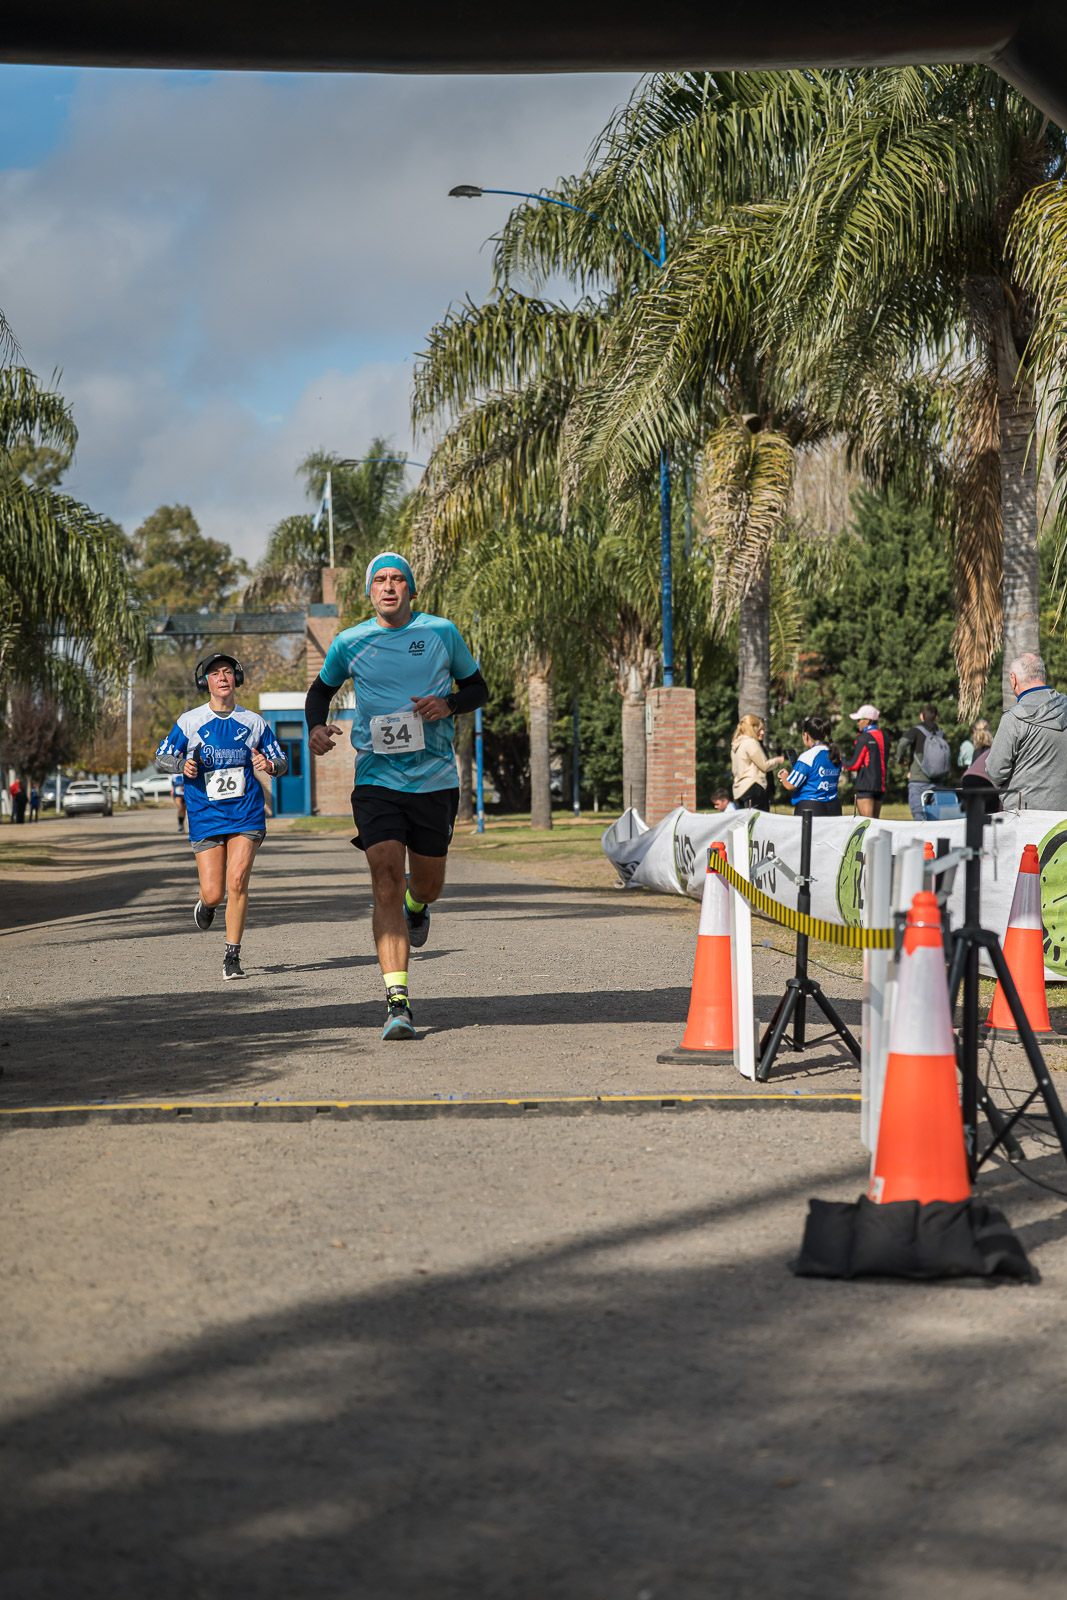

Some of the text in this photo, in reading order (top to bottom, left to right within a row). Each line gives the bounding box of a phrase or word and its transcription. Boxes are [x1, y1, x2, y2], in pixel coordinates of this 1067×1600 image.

[409, 640, 425, 649] AG
[380, 723, 412, 745] 34
[203, 744, 215, 768] 3
[216, 776, 237, 793] 26
